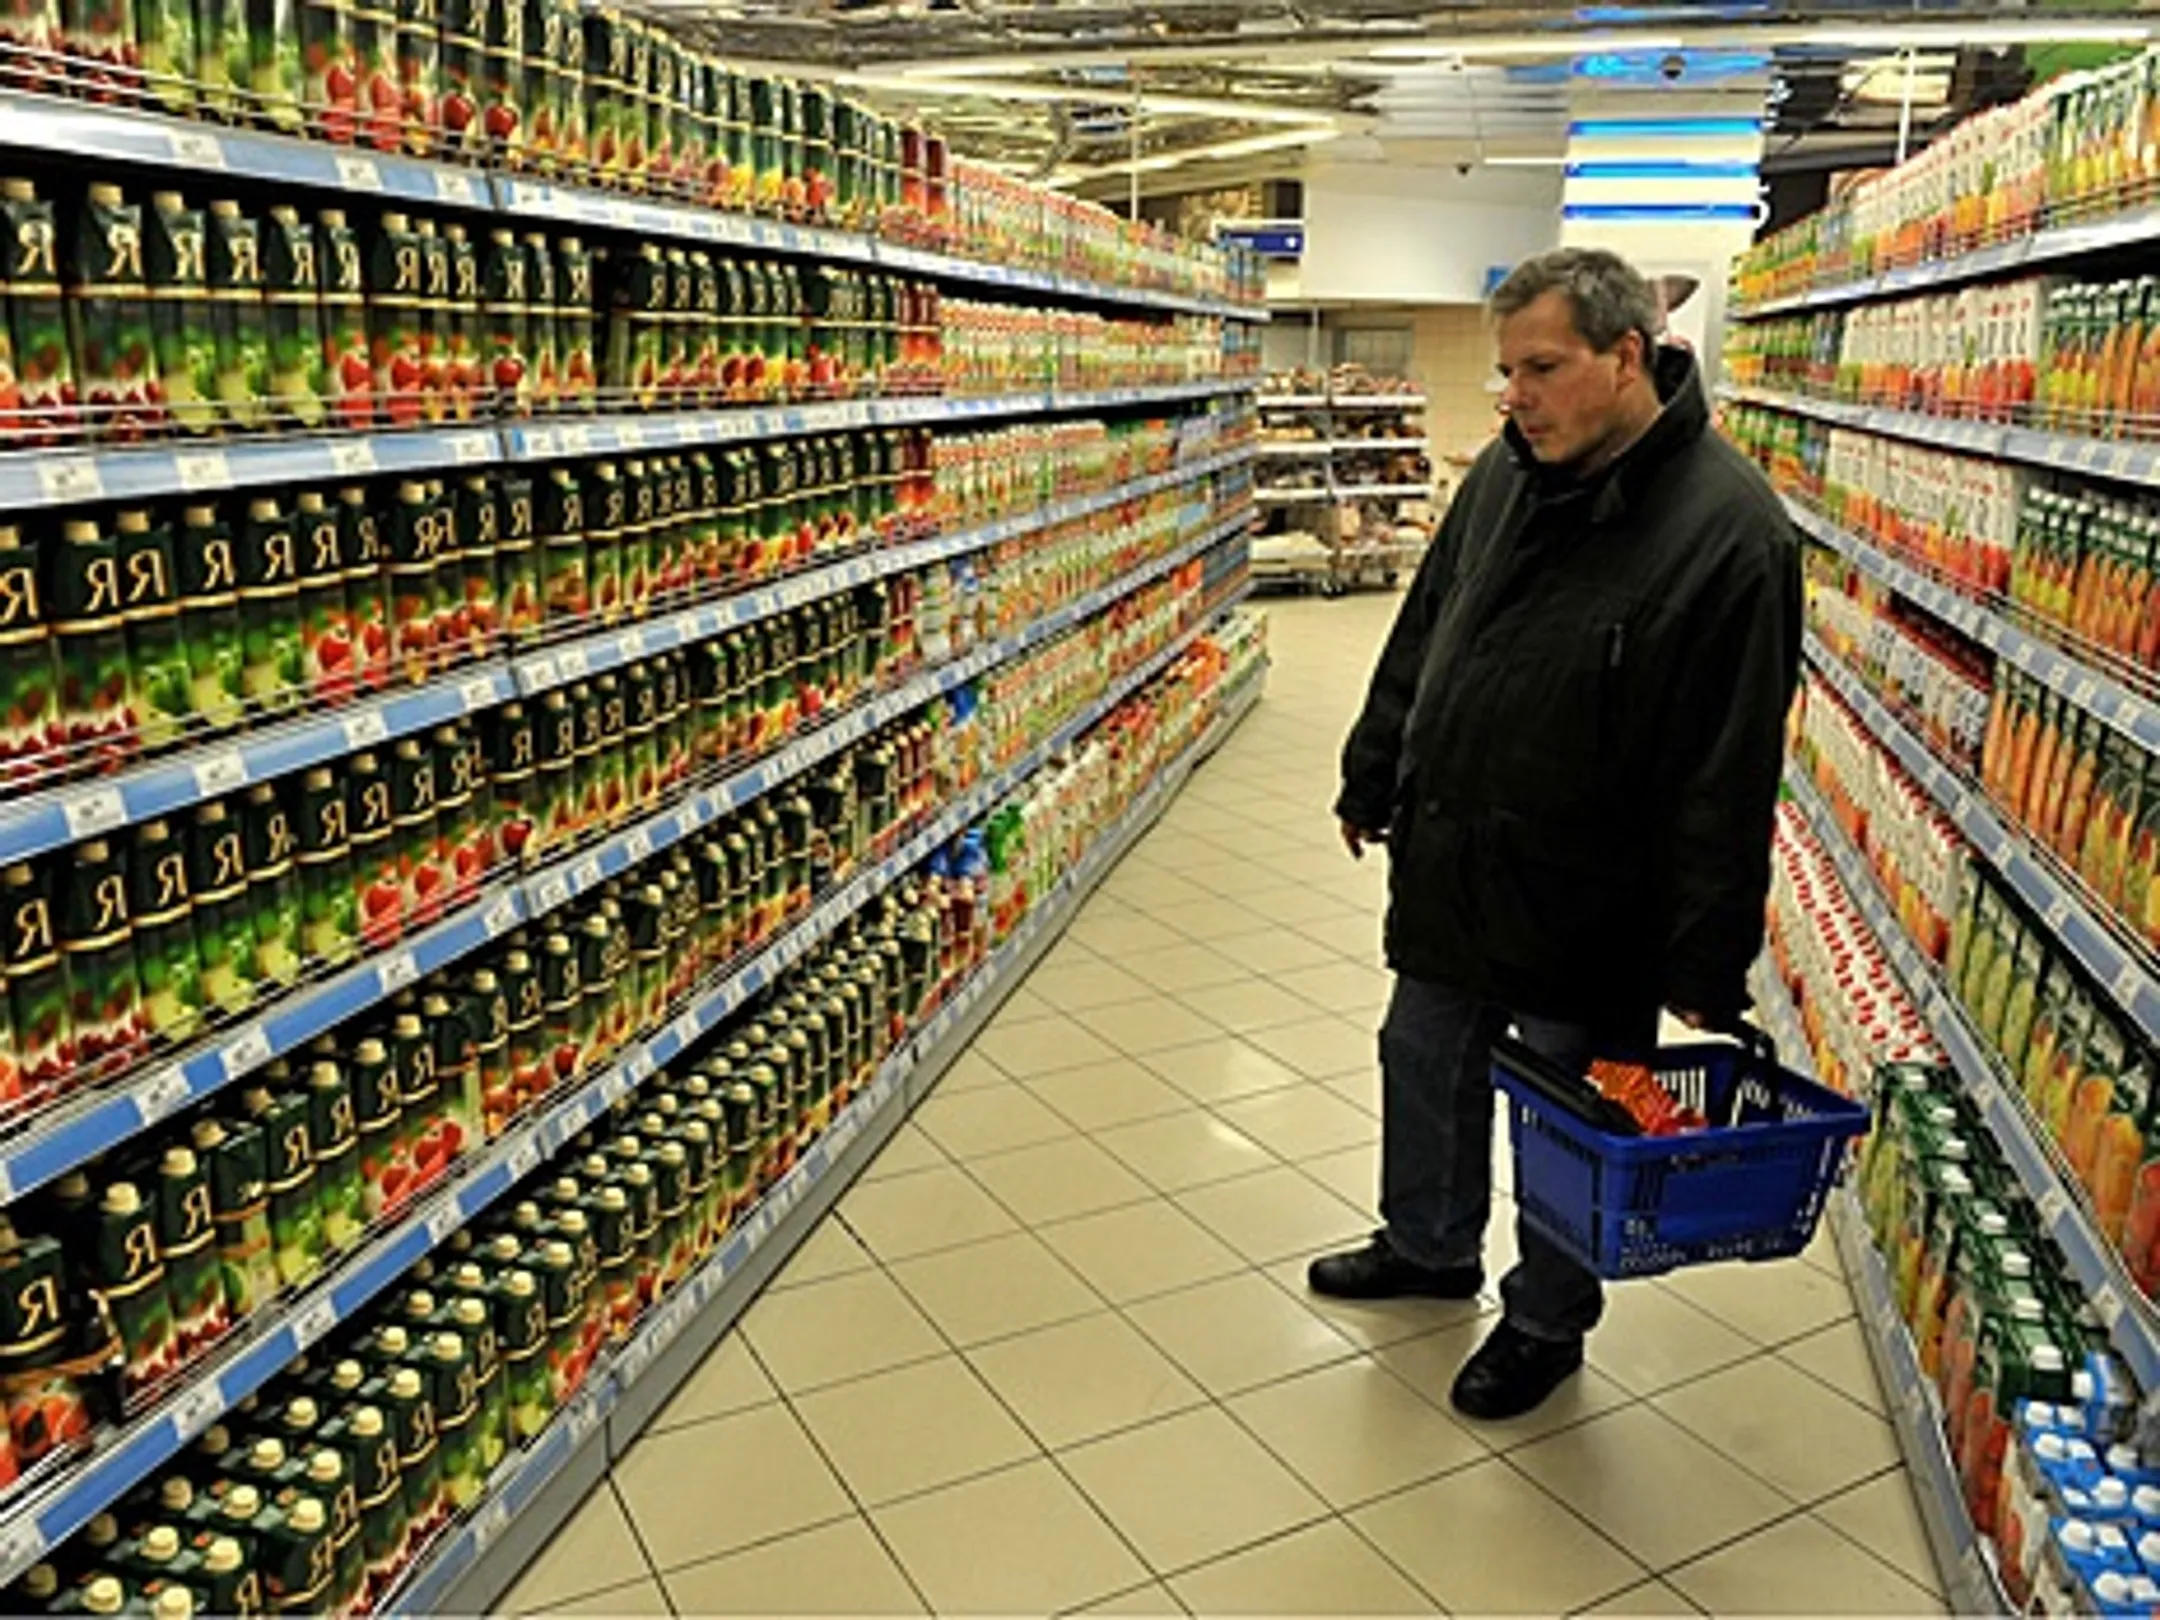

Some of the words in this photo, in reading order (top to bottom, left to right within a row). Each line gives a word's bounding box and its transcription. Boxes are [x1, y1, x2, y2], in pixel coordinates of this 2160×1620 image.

[18, 221, 56, 275] Я
[105, 223, 142, 276] Я
[172, 230, 205, 280] Я
[227, 236, 259, 282] Я
[291, 242, 316, 285] Я
[337, 242, 361, 288] Я
[395, 247, 419, 290] Я
[427, 251, 447, 294] Я
[456, 256, 476, 295] Я
[413, 515, 437, 558] Я
[478, 503, 496, 541] Я
[511, 497, 532, 537] Я
[563, 494, 583, 532] Я
[264, 533, 295, 582] Я
[312, 524, 340, 570] Я
[359, 516, 379, 560] Я
[84, 558, 119, 612] Я
[127, 549, 166, 602] Я
[203, 540, 235, 590] Я
[0, 567, 39, 624] Я
[511, 728, 532, 767] Я
[555, 716, 574, 755] Я
[413, 766, 435, 808] Я
[452, 750, 471, 792] Я
[320, 800, 347, 845] Я
[362, 781, 389, 827] Я
[213, 833, 244, 885] Я
[267, 813, 291, 861] Я
[94, 874, 128, 931] Я
[157, 853, 189, 906] Я
[14, 900, 52, 956] Я
[412, 1043, 434, 1087] Я
[377, 1068, 400, 1113] Я
[331, 1094, 355, 1141] Я
[284, 1126, 311, 1174] Я
[182, 1185, 212, 1238] Я
[123, 1222, 157, 1280] Я
[18, 1276, 59, 1337] Я
[412, 1401, 434, 1448] Я
[375, 1438, 397, 1490] Я
[335, 1484, 358, 1533] Я
[308, 1535, 333, 1587] Я
[235, 1571, 261, 1615] Я
